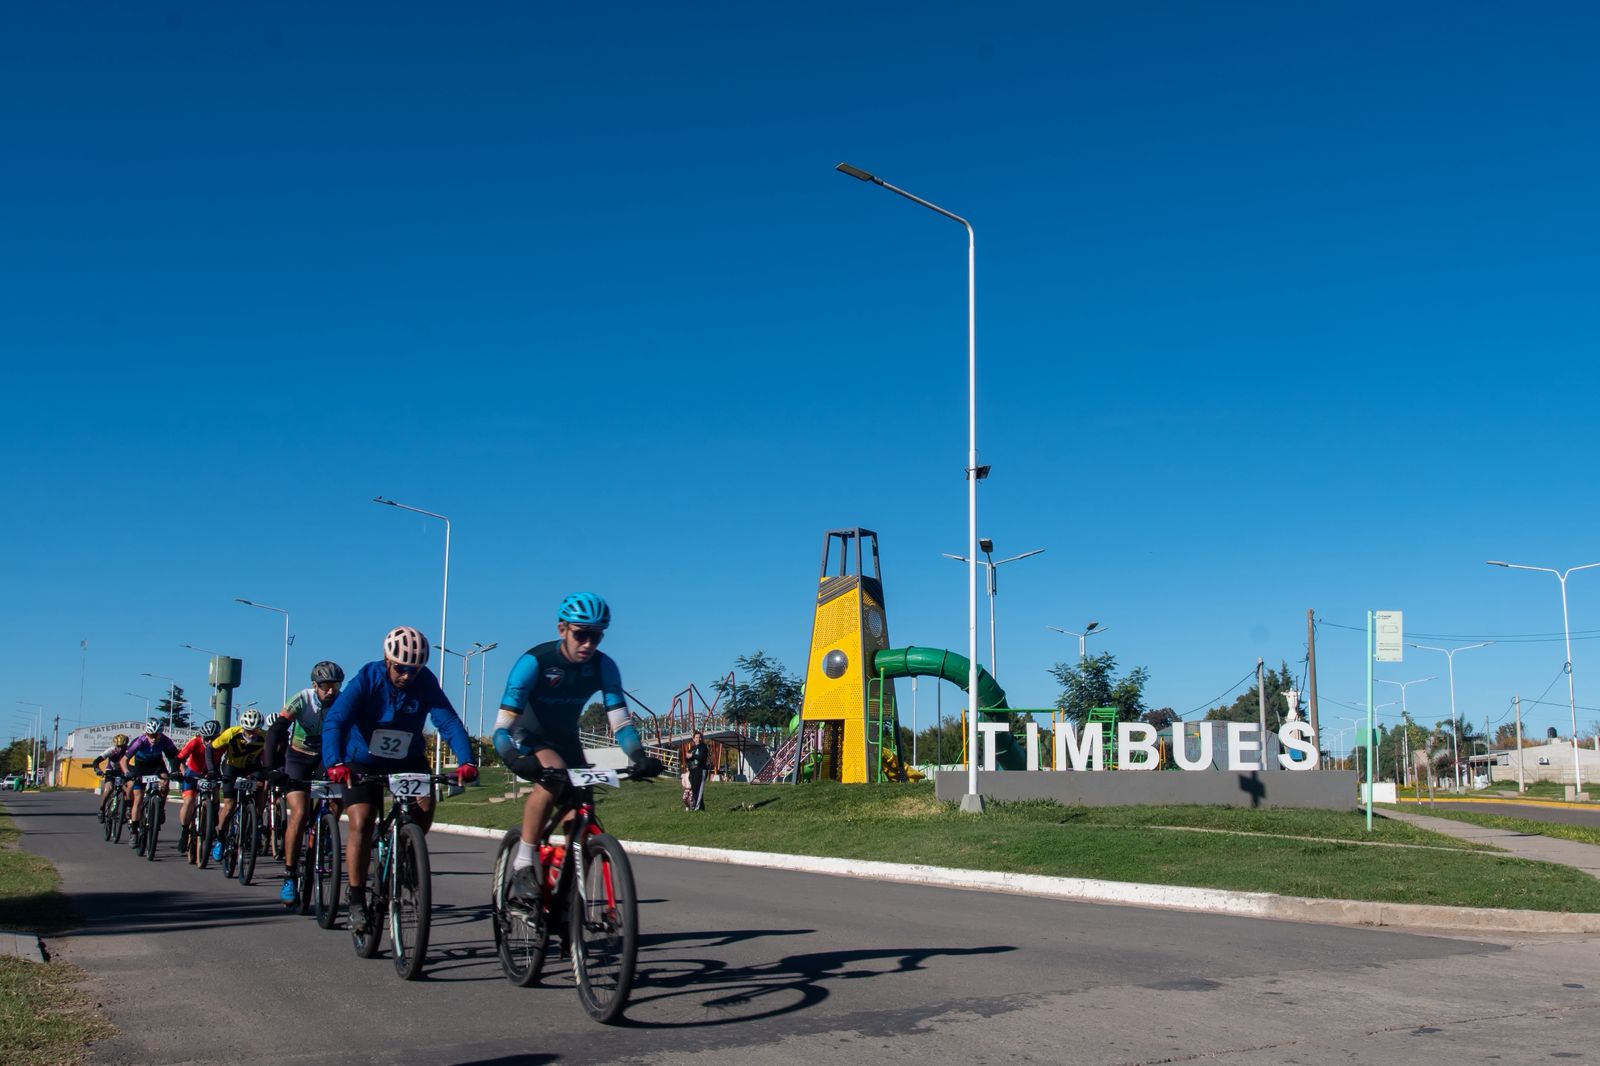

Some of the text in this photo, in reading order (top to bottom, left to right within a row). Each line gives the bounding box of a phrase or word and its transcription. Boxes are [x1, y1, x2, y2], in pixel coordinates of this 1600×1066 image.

[90, 723, 141, 733] MATERIALES
[380, 736, 401, 752] 32
[978, 721, 1320, 772] TIMBUES
[580, 773, 609, 784] 25
[399, 779, 421, 795] 32
